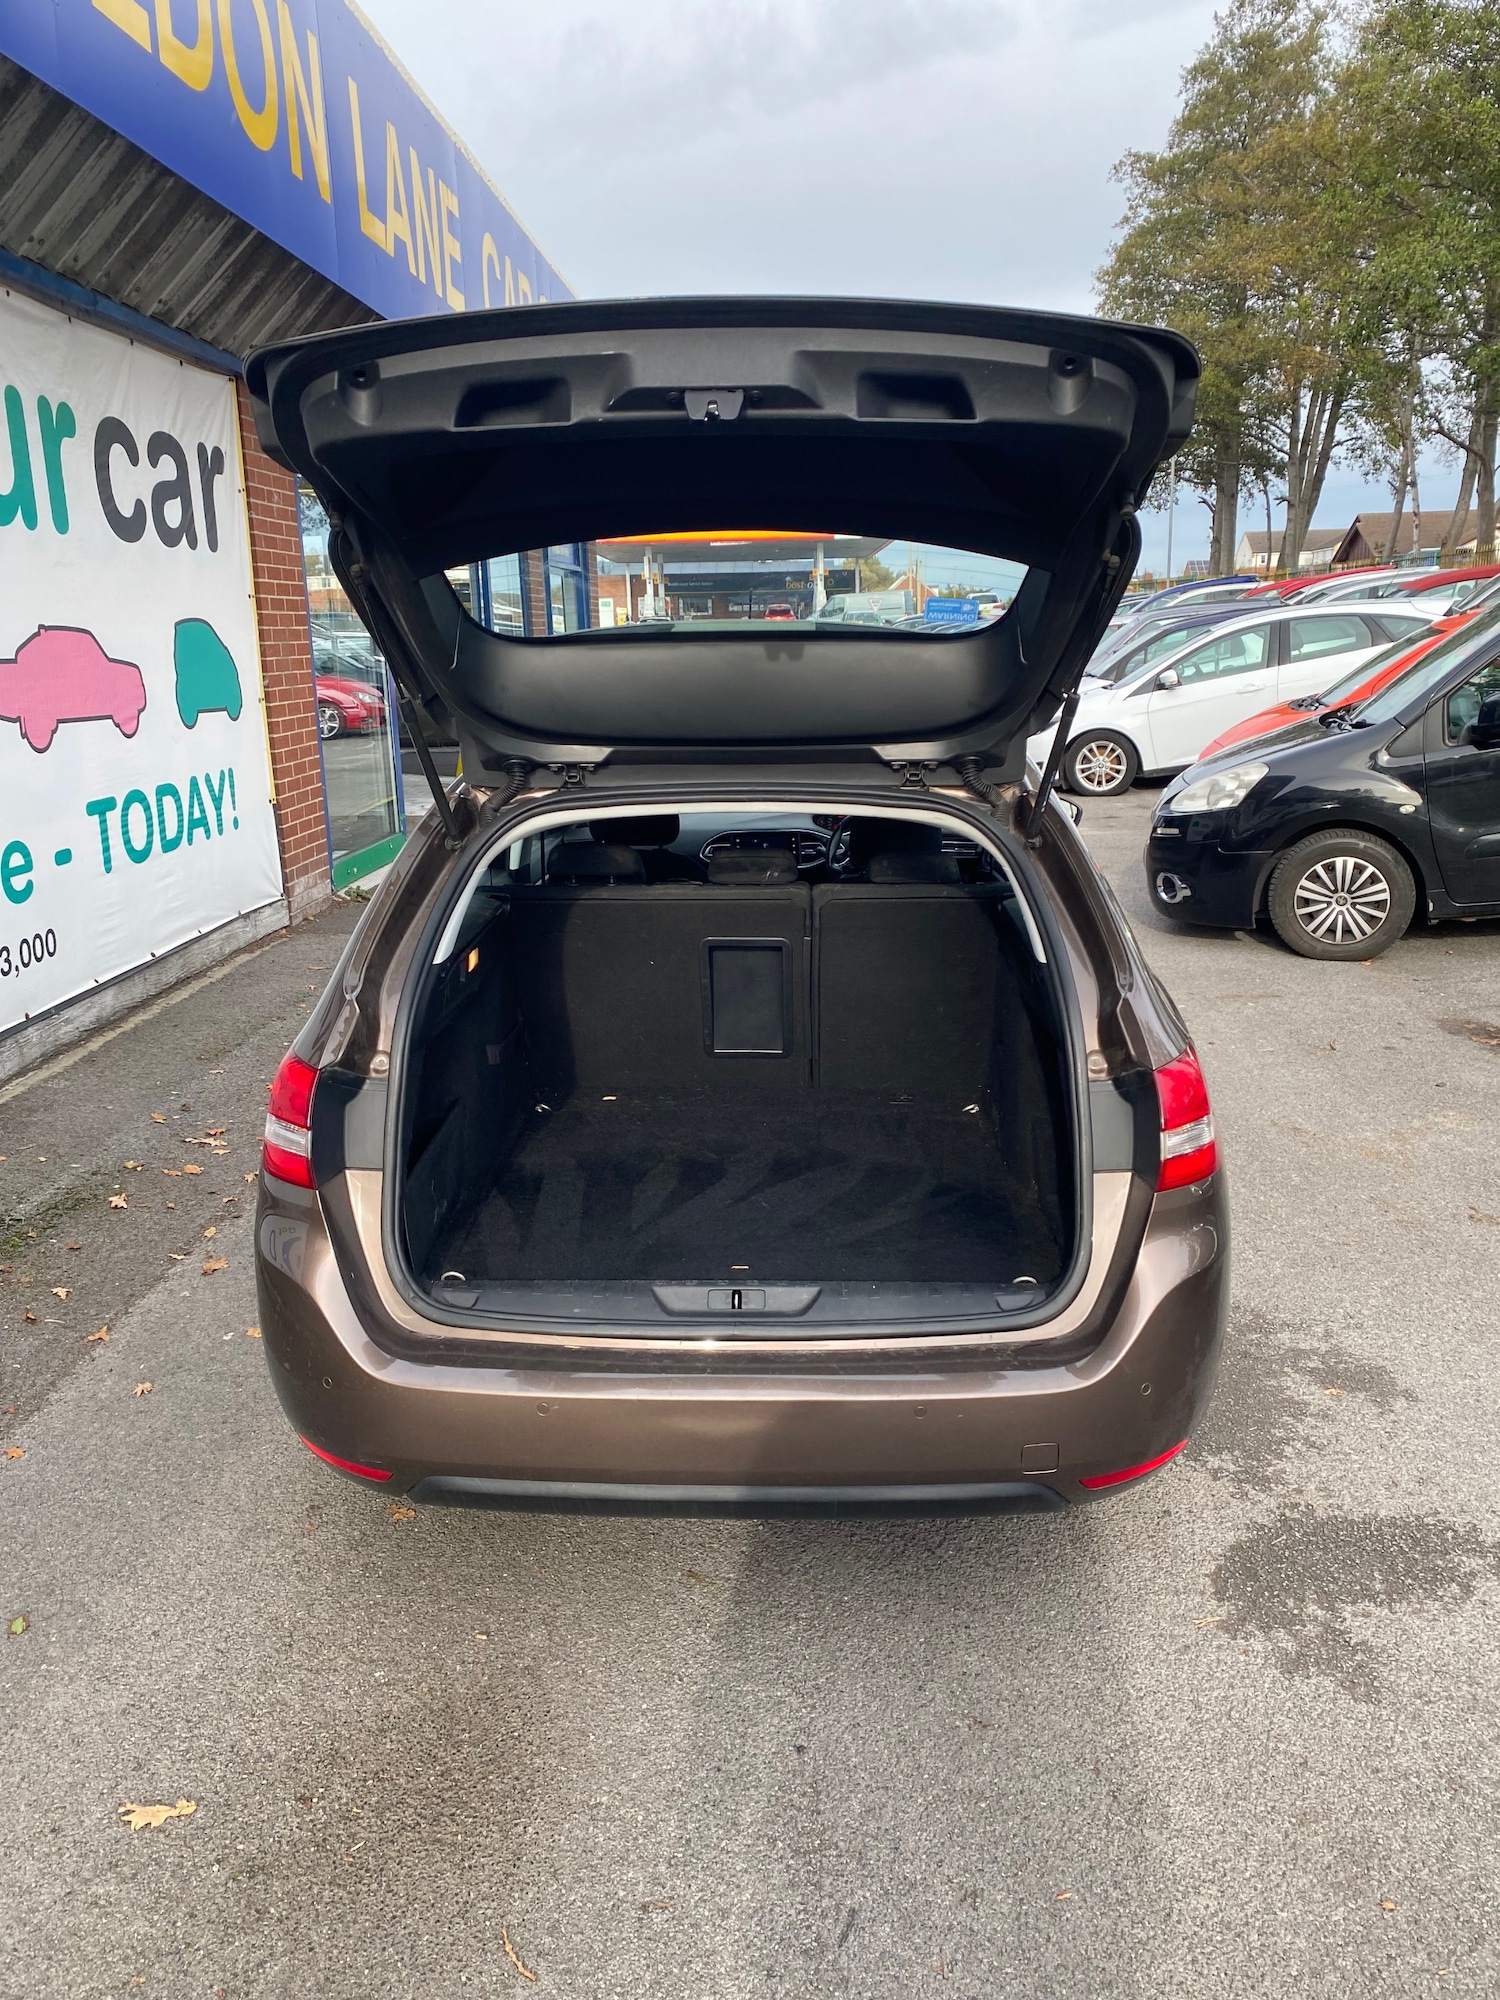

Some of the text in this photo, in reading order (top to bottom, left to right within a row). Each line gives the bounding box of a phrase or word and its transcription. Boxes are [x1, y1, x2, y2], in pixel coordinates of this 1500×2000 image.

[92, 0, 547, 312] ON LANE CA
[94, 416, 224, 553] car
[86, 767, 239, 874] TODAY!
